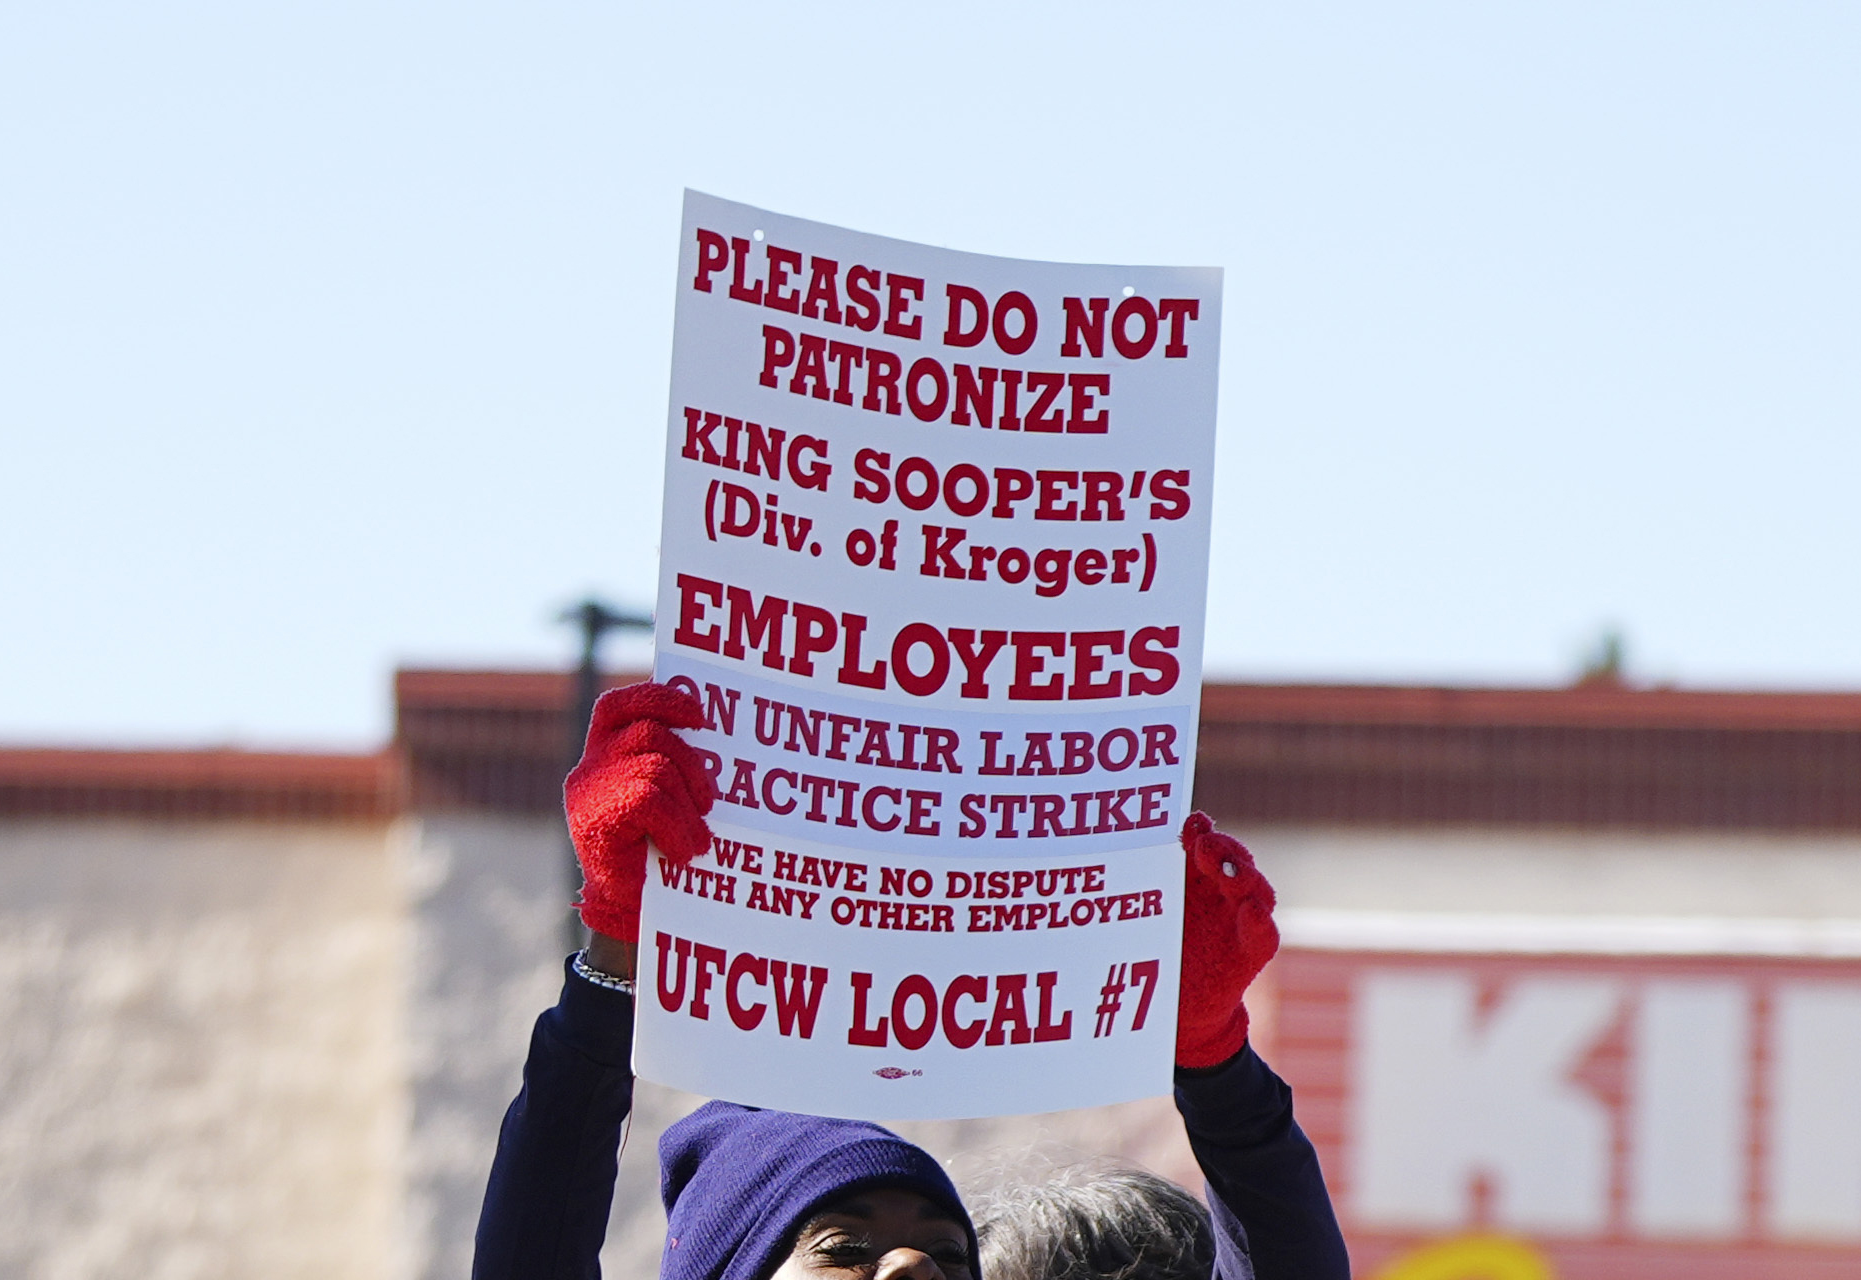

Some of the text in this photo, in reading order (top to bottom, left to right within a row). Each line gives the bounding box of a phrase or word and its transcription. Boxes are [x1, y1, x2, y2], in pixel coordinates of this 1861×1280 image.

[693, 227, 1200, 360] PLEASE DO NOT
[759, 324, 1111, 434] PATRONIZE
[680, 406, 1191, 522] KING SOOPER'S
[704, 479, 1158, 598] (Div. of Kroger)
[674, 572, 1181, 702] EMPLOYEES
[694, 746, 1171, 840] RACTICE STRIKE
[752, 696, 963, 774] UNFAIR
[977, 723, 1180, 777] LABOR
[658, 857, 1164, 933] WITH ANY OTHER EMPLOYER
[712, 836, 1106, 900] WE HAVE NO DISPUTE
[655, 931, 1161, 1050] UFCW LOCAL #7
